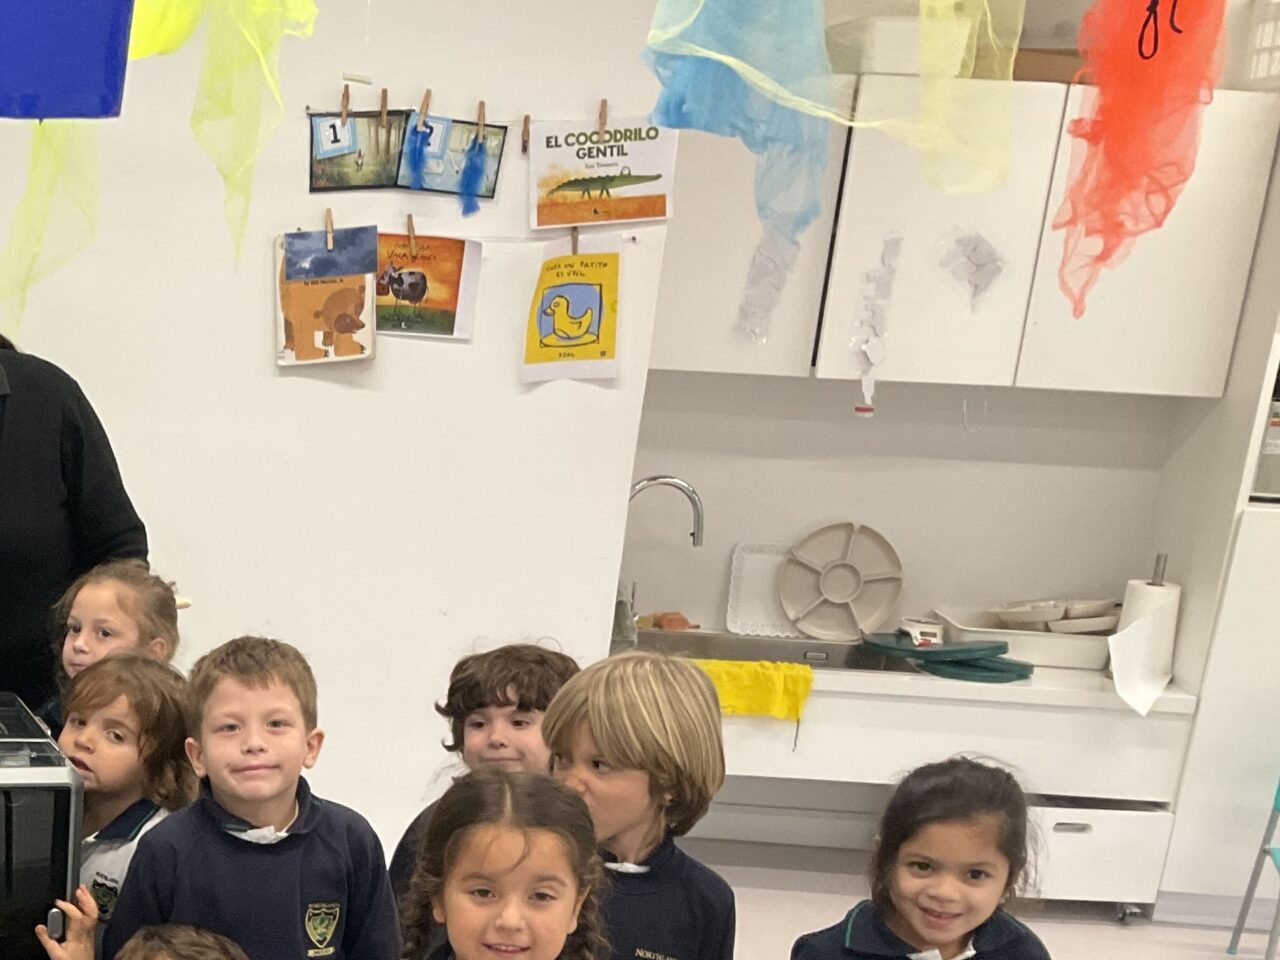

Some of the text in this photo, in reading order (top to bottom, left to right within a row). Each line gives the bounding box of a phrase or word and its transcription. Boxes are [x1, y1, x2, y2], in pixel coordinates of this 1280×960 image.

[328, 123, 341, 144] 1
[546, 126, 659, 148] EL COCODRILO
[576, 144, 628, 160] GENTIL
